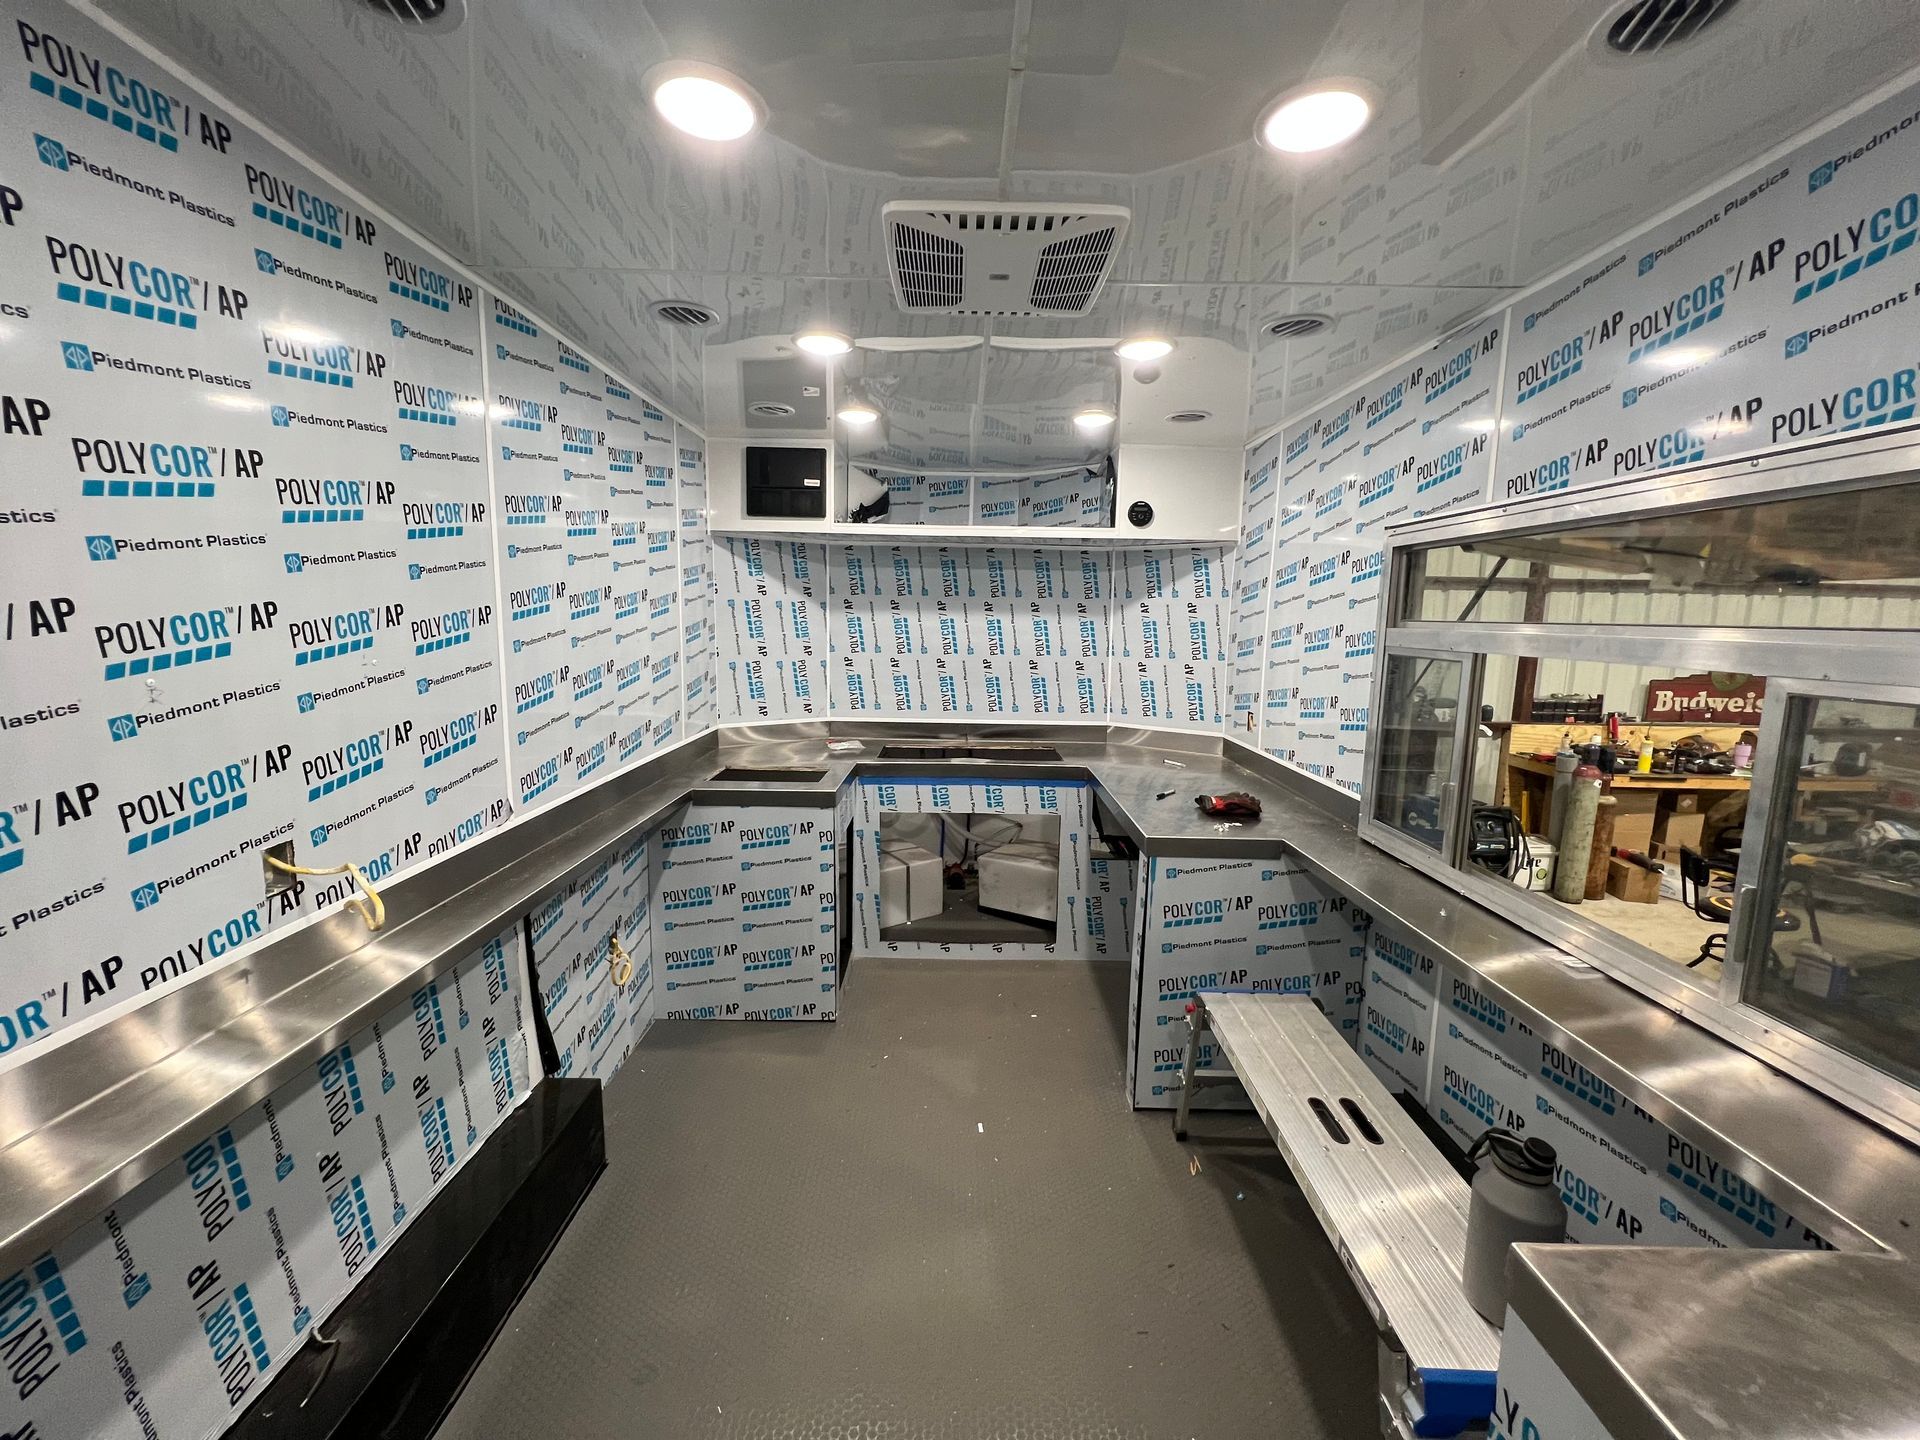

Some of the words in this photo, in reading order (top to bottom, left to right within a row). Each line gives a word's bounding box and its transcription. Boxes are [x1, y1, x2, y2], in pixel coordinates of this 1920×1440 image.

[200, 112, 232, 154] AP
[66, 150, 165, 201] Piedmont
[168, 191, 235, 228] Plastics
[1654, 213, 1720, 262] Piedmont
[1724, 167, 1790, 216] Plastics
[355, 215, 376, 246] AP
[1748, 238, 1786, 282] AP
[274, 258, 333, 289] Piedmont
[335, 280, 378, 304] Plastics
[1535, 286, 1581, 321] Piedmont
[1583, 254, 1627, 289] Plastics
[218, 285, 248, 320] AP
[458, 283, 473, 308] AP
[1599, 310, 1624, 345] AP
[1808, 292, 1909, 343] Piedmont
[402, 325, 443, 346] Piedmont
[444, 339, 474, 356] Plastics
[1481, 329, 1498, 355] AP
[92, 350, 184, 380] Piedmont
[188, 368, 251, 389] Plastics
[366, 351, 386, 378] AP
[2, 395, 51, 436] AP
[1430, 401, 1460, 426] Piedmont
[1524, 407, 1567, 433] Piedmont
[1570, 382, 1612, 410] Plastics
[288, 411, 345, 429] Piedmont
[347, 418, 388, 434] Plastics
[411, 449, 450, 460] Piedmont
[451, 452, 480, 463] Plastics
[1472, 433, 1488, 457] AP
[1585, 438, 1608, 467] AP
[235, 448, 264, 478] AP
[376, 481, 395, 505] AP
[552, 495, 562, 512] AP
[1021, 497, 1031, 508] AP
[471, 503, 486, 523] AP
[115, 537, 203, 552] Piedmont
[206, 533, 267, 548] Plastics
[301, 552, 355, 566] Piedmont
[357, 549, 397, 560] Plastics
[419, 563, 457, 575] Piedmont
[459, 560, 487, 571] Plastics
[556, 582, 566, 599] AP
[29, 597, 76, 637] AP
[250, 601, 278, 632] AP
[385, 603, 404, 627] AP
[478, 605, 492, 627] AP
[1188, 602, 1198, 614] AP
[758, 646, 767, 657] AP
[313, 679, 366, 704] Piedmont
[367, 668, 406, 686] Plastics
[427, 671, 464, 688] Piedmont
[466, 660, 493, 675] Plastics
[559, 665, 570, 681] AP
[135, 695, 221, 729] Piedmont
[222, 680, 281, 705] Plastics
[484, 704, 498, 726] AP
[394, 720, 413, 746] AP
[265, 744, 292, 777] AP
[564, 747, 573, 763] AP
[56, 782, 100, 827] AP
[326, 803, 377, 834] Piedmont
[377, 782, 415, 807] Plastics
[491, 799, 504, 823] AP
[720, 820, 735, 833] AP
[799, 821, 814, 834] AP
[157, 848, 238, 894] Piedmont
[239, 820, 295, 855] Plastics
[404, 832, 422, 860] AP
[1177, 866, 1217, 876] Piedmont
[1219, 862, 1252, 872] Plastics
[722, 882, 736, 896] AP
[800, 883, 815, 896] AP
[1235, 895, 1253, 911] AP
[12, 879, 106, 930] Plastics
[1330, 897, 1348, 912] AP
[1172, 940, 1212, 950] Piedmont
[1214, 937, 1247, 946] Plastics
[81, 955, 124, 1005] AP
[1230, 969, 1248, 985] AP
[372, 1022, 388, 1079] Piedmont
[1458, 1032, 1493, 1061] Piedmont
[1495, 1053, 1528, 1080] Plastics
[262, 1098, 285, 1163] Piedmont
[1507, 1108, 1525, 1131] AP
[1549, 1105, 1597, 1143] Piedmont
[1599, 1137, 1647, 1175] Plastics
[318, 1151, 343, 1183] AP
[1616, 1208, 1643, 1239] AP
[105, 1210, 137, 1286] Piedmont
[187, 1259, 221, 1300] AP
[282, 1255, 304, 1316] Piedmont
